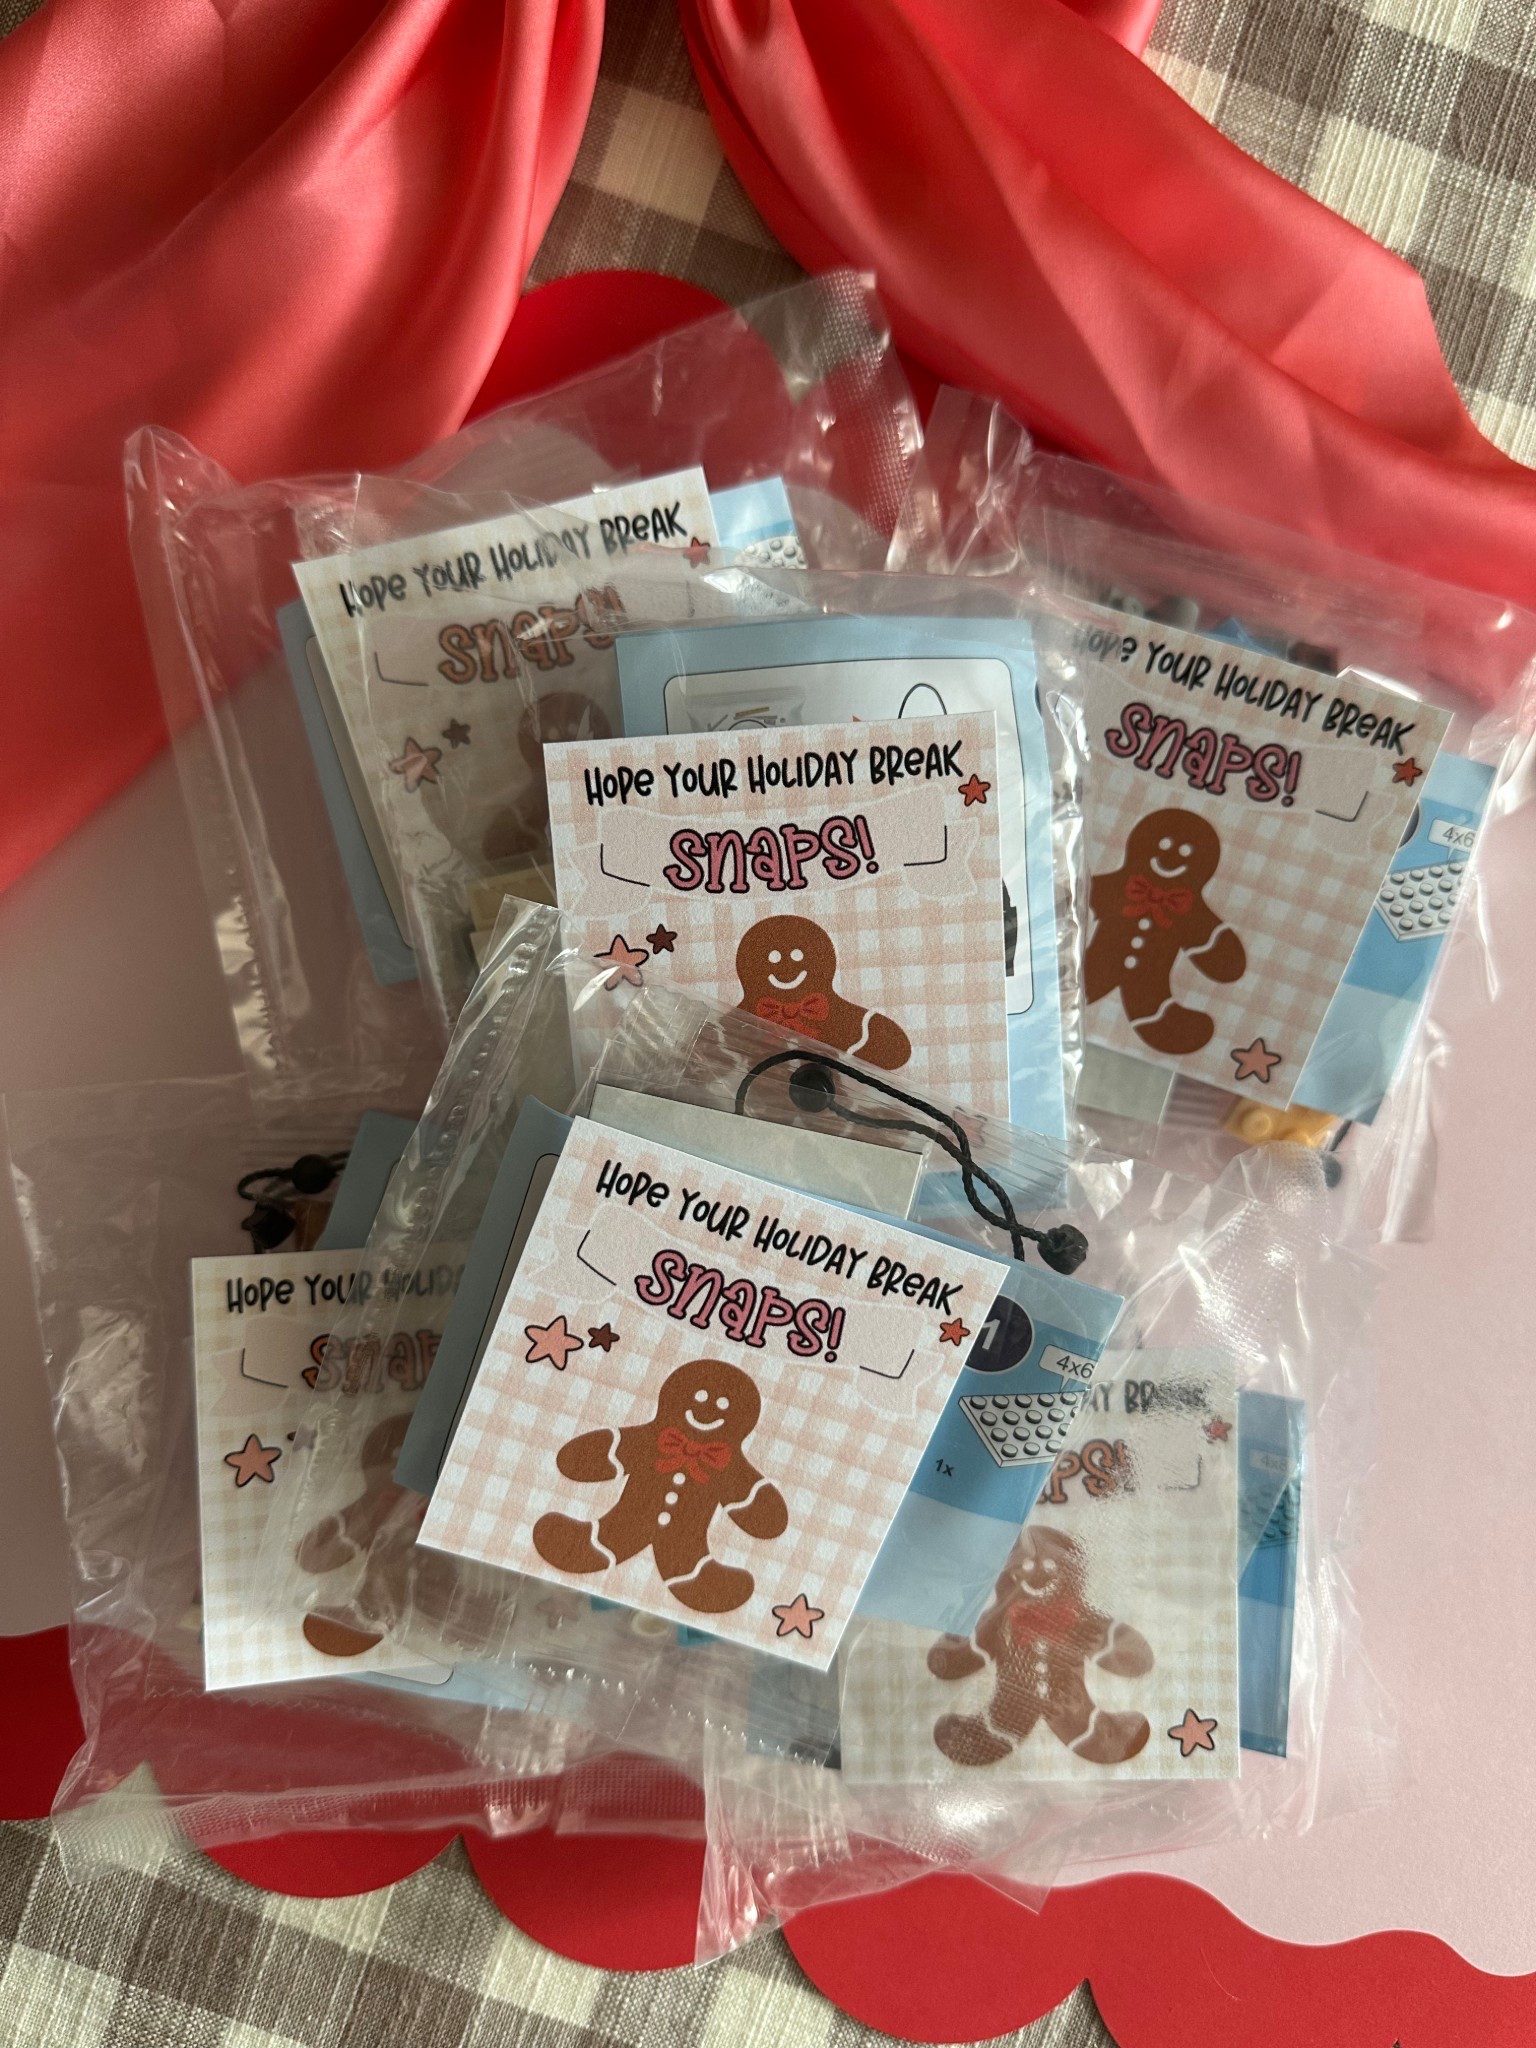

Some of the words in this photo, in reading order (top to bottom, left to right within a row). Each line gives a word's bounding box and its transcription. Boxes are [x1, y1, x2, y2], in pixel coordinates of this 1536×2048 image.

[1145, 641, 1212, 691] YOUR
[1214, 663, 1323, 723] HOLIDAY
[663, 758, 739, 798] YOUR
[747, 748, 859, 795] HOLIDAY
[1442, 826, 1476, 848] 4x6
[678, 1188, 750, 1242] YOUR
[753, 1215, 868, 1279] HOLIDAY
[982, 1318, 1001, 1350] 1
[1056, 1355, 1095, 1379] 4x6
[935, 1458, 955, 1477] 1x
